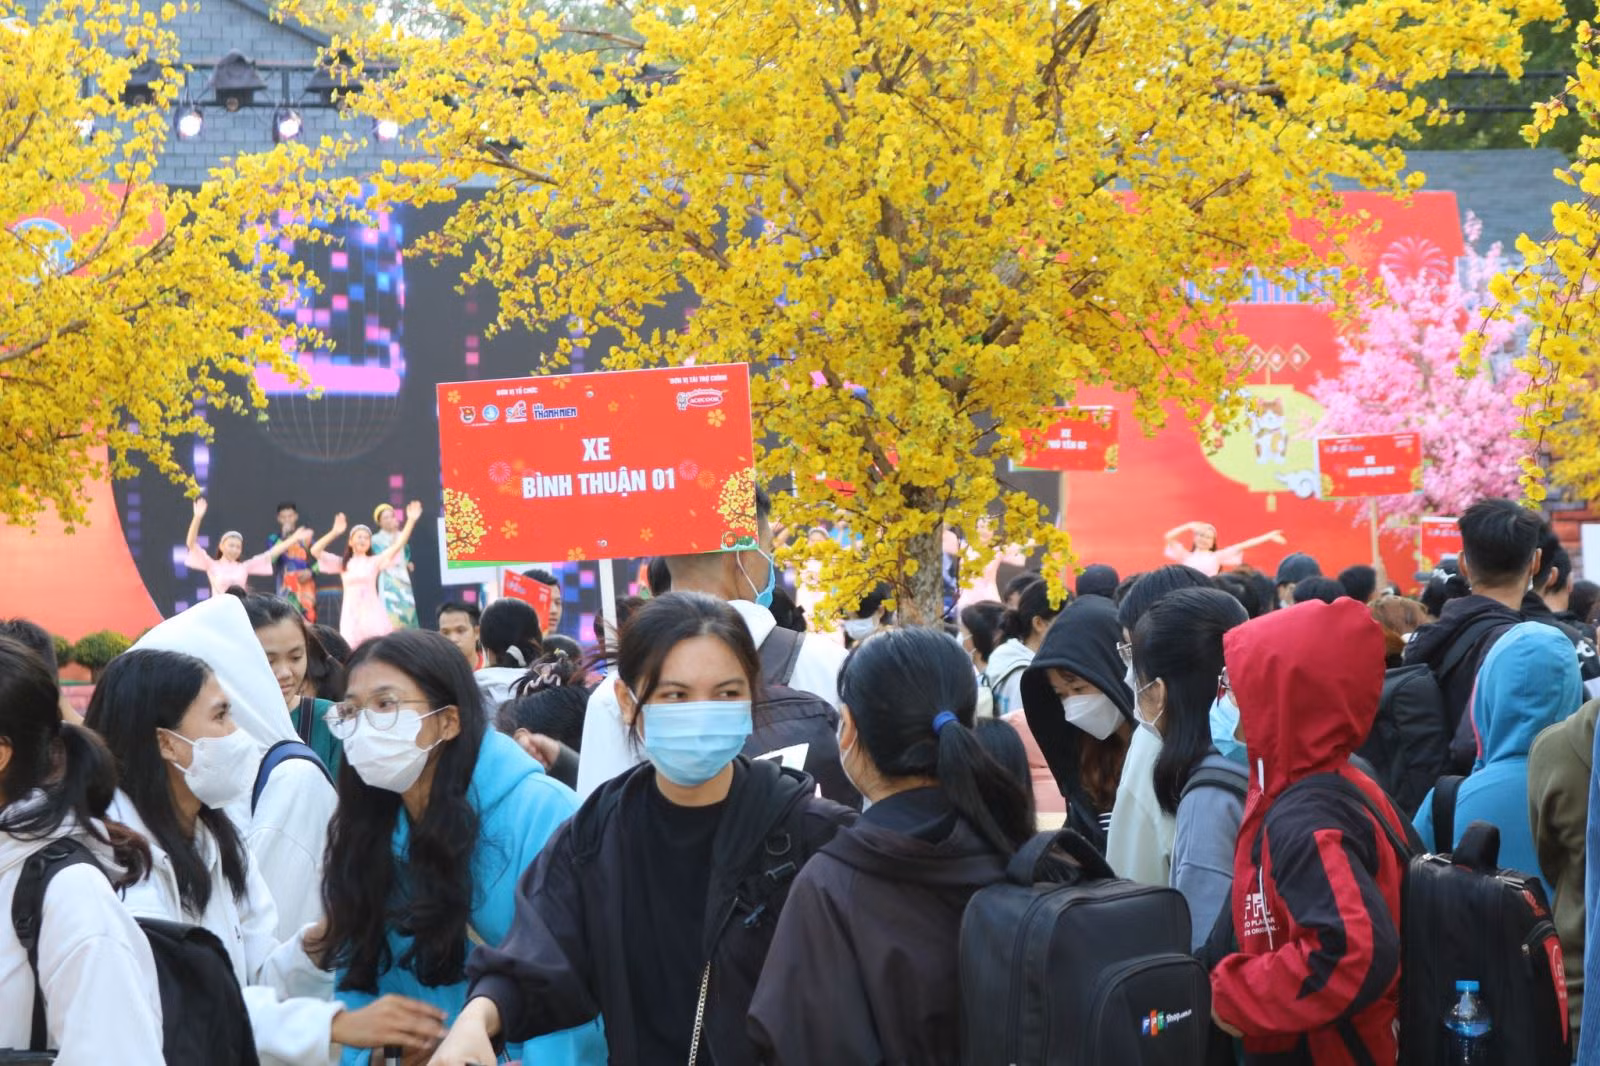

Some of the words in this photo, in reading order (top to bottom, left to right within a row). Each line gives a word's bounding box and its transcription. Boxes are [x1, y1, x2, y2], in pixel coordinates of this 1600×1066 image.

[582, 437, 611, 462] XE
[522, 471, 573, 499] BÌNH
[577, 465, 647, 497] THUẬN
[652, 467, 675, 491] 01
